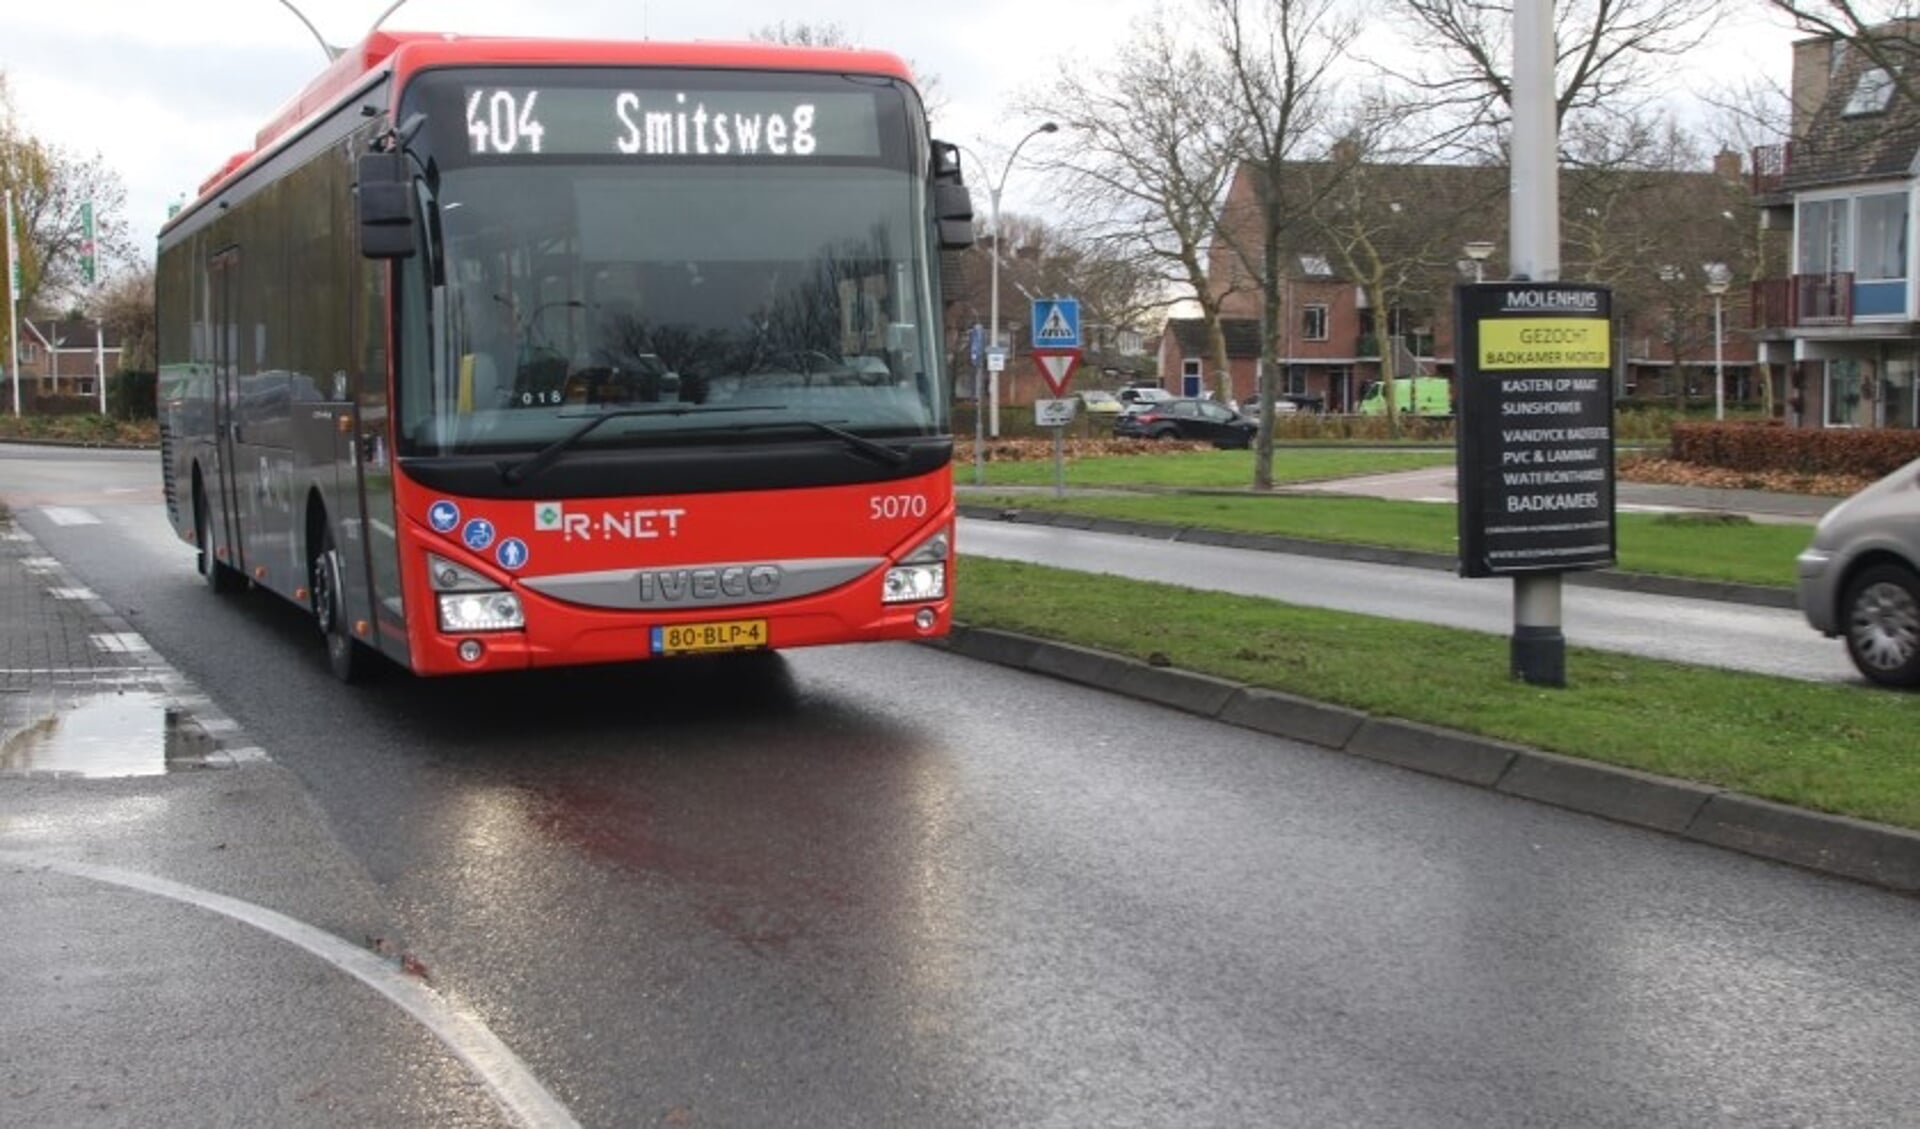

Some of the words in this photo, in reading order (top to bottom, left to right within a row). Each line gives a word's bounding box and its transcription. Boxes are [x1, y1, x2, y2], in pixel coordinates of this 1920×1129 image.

[466, 90, 544, 153] 404
[616, 92, 816, 155] Smitsweg
[1507, 289, 1597, 308] MOLENHUIS
[1519, 328, 1588, 344] GEZOCHT
[1486, 351, 1561, 364] BADKAMER
[1502, 379, 1553, 392] KASTEN
[1556, 379, 1571, 392] OP
[1503, 451, 1531, 464] PVC
[1533, 449, 1544, 463] &
[870, 495, 927, 519] 5070
[1507, 492, 1598, 512] BADKAMERS
[640, 565, 780, 601] IVECO
[669, 624, 760, 647] 80-BLP-4
